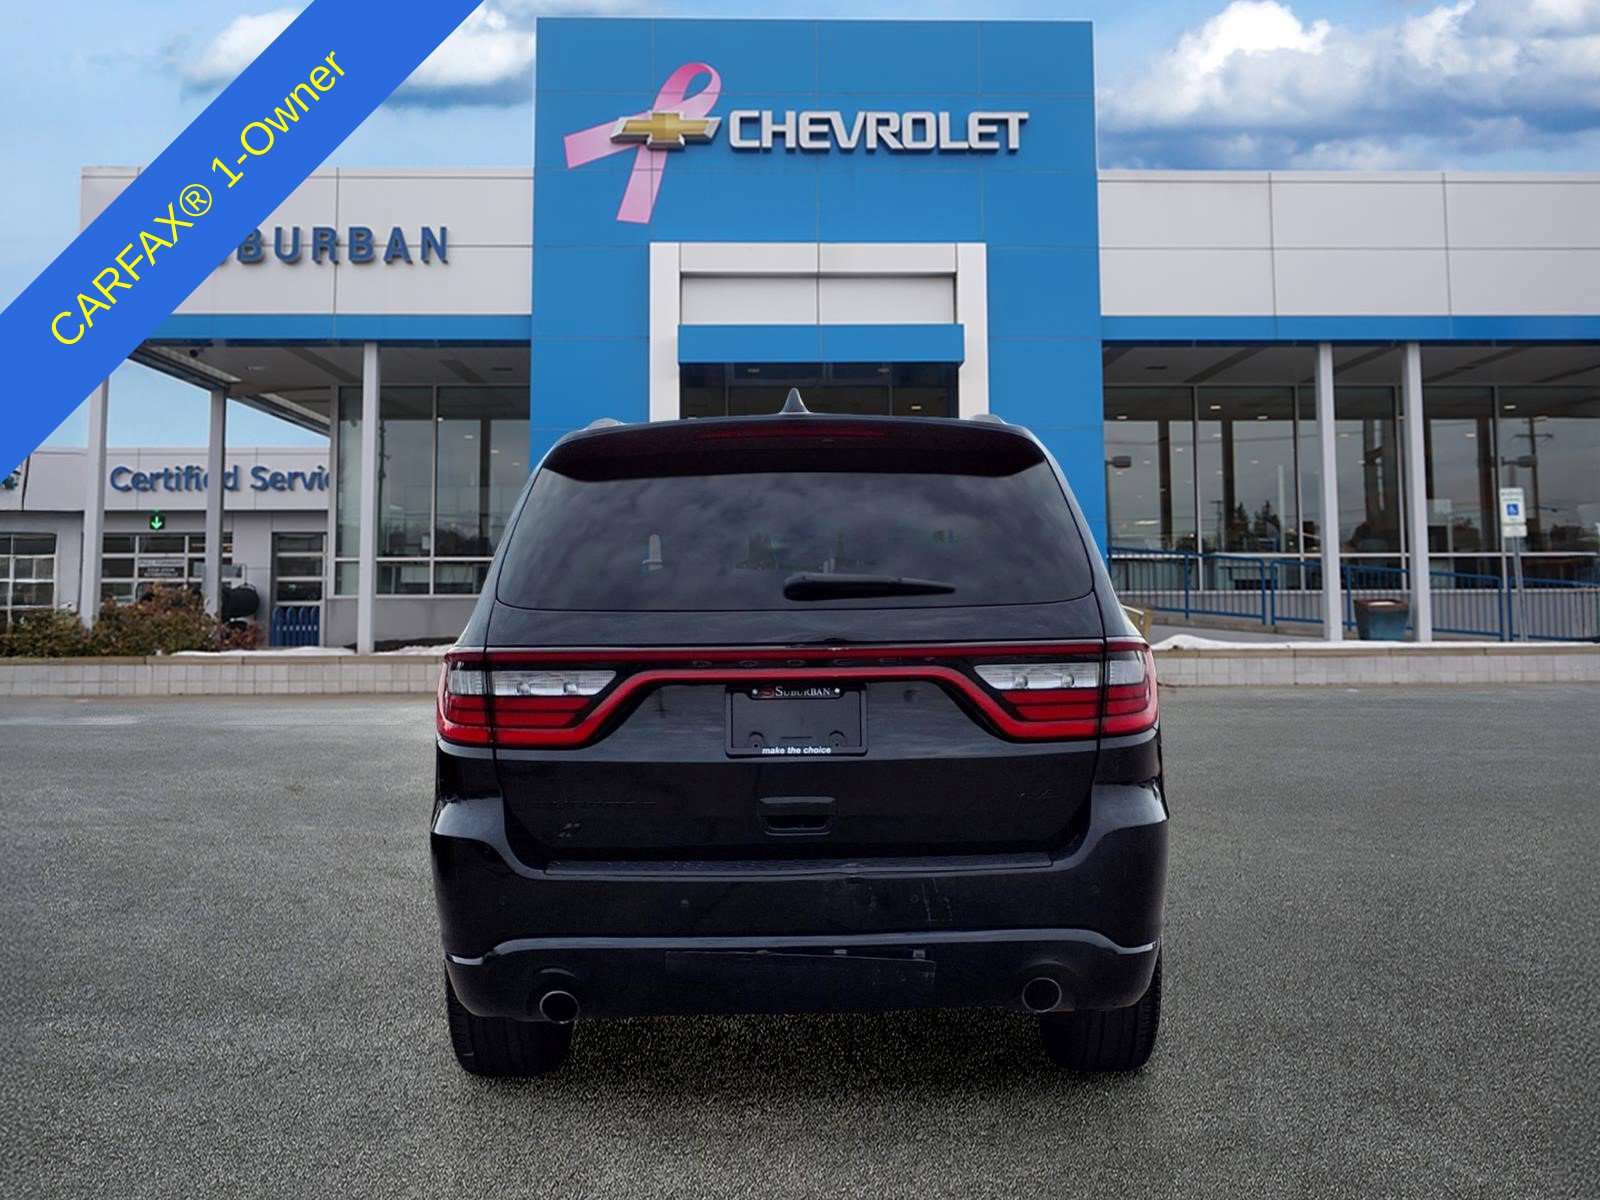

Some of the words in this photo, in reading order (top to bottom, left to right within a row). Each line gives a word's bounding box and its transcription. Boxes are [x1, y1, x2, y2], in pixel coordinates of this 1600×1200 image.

[728, 109, 1029, 151] CHEVROLET
[219, 226, 449, 265] BURBAN
[761, 746, 785, 755] make
[787, 746, 801, 755] the
[803, 746, 832, 755] choice
